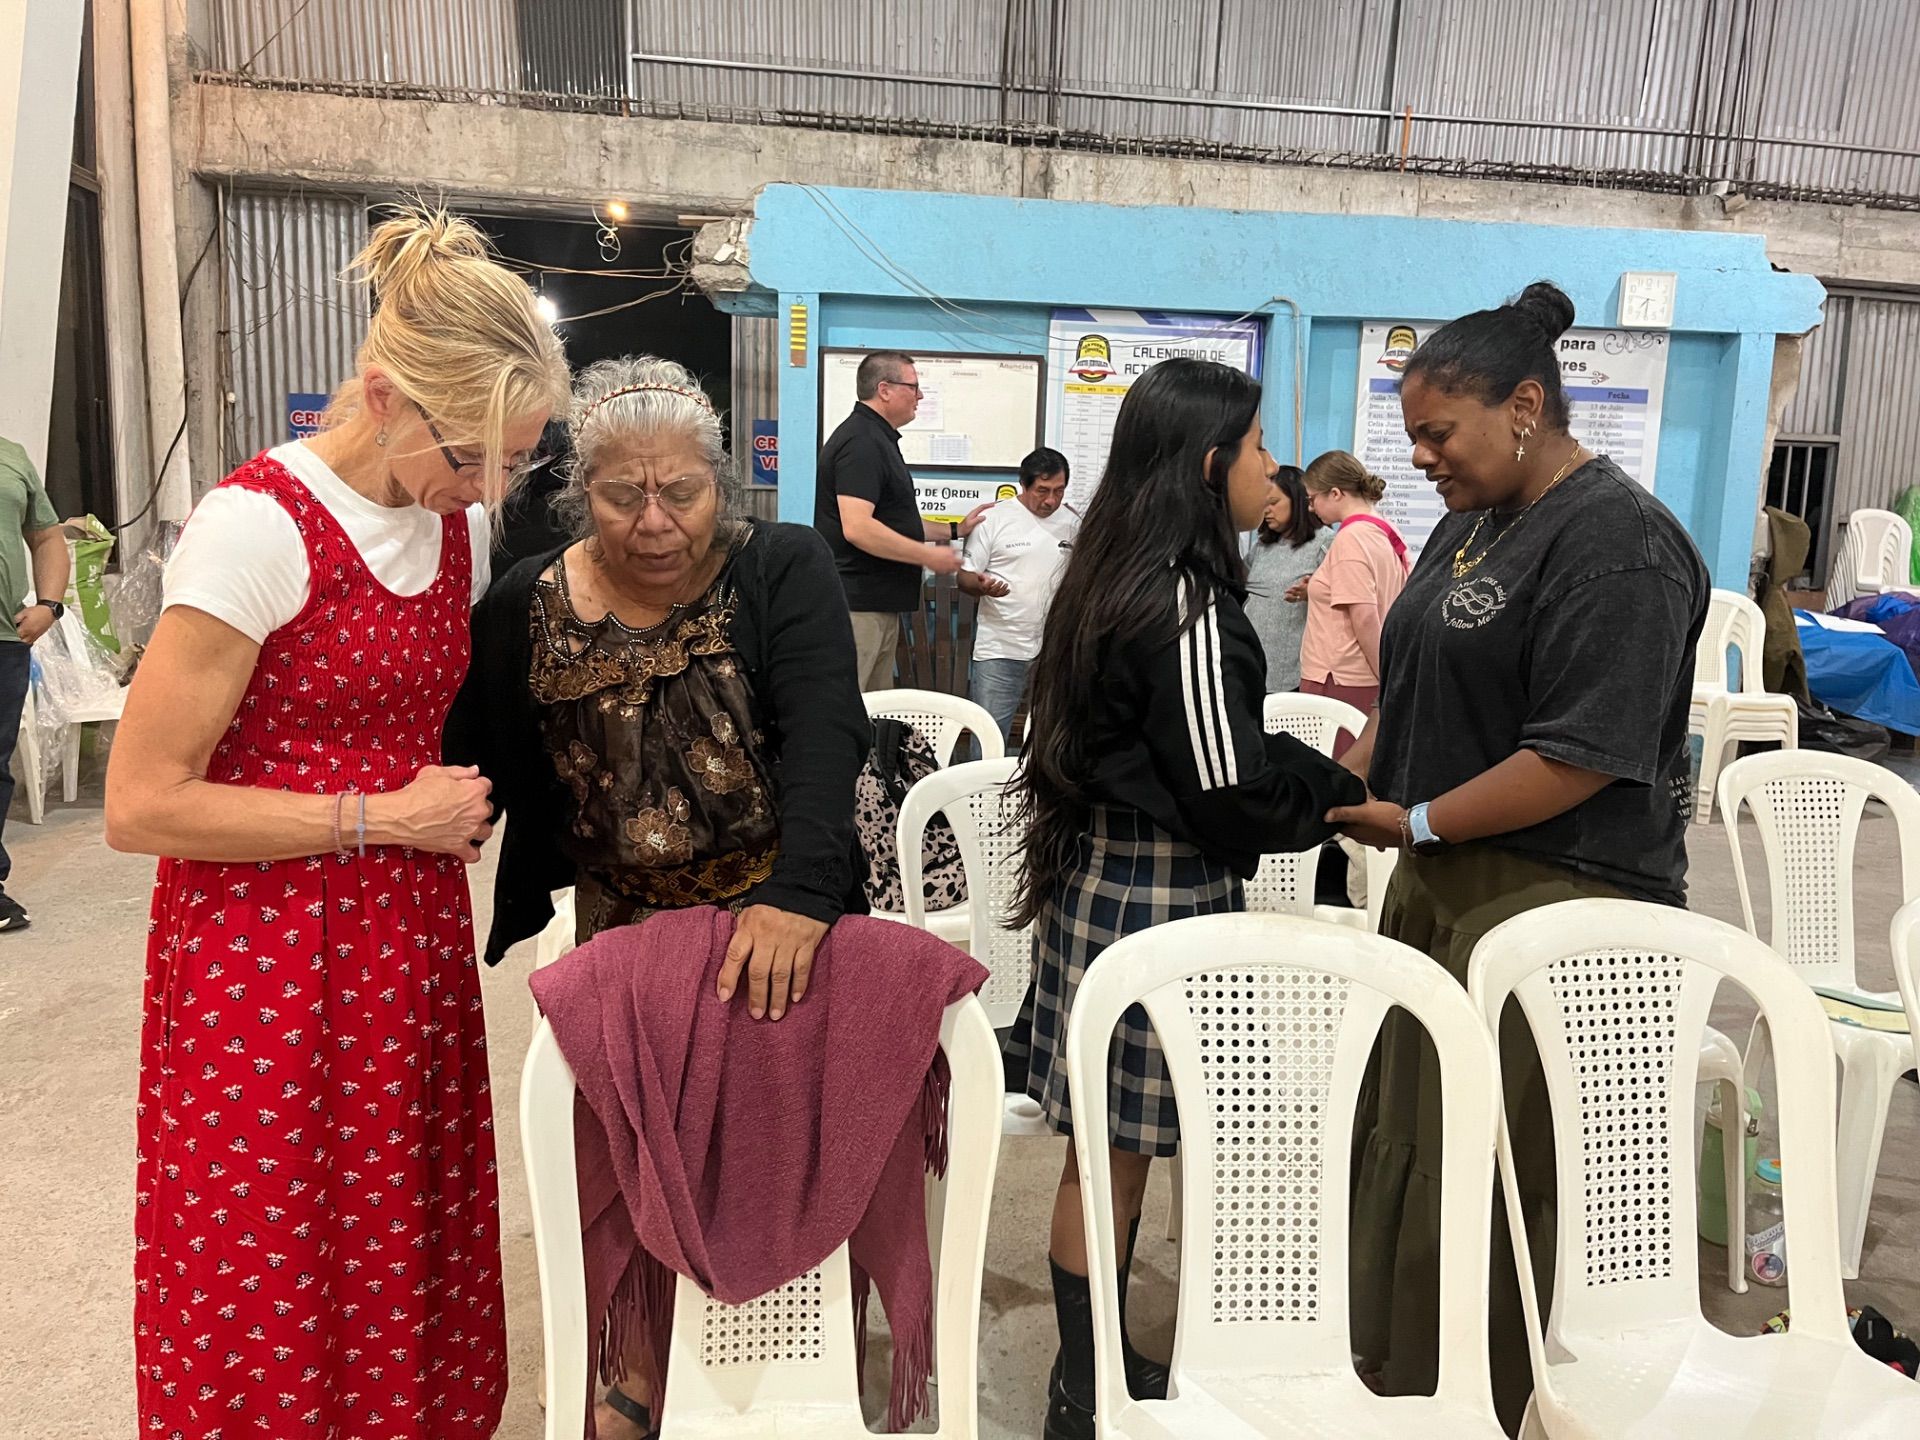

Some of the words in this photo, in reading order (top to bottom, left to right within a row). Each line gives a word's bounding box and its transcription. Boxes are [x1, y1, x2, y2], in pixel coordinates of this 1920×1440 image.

[1560, 339, 1596, 352] para
[1133, 347, 1207, 359] CALENDARIO
[1210, 350, 1226, 361] DE
[1124, 363, 1151, 375] ACT
[1560, 361, 1587, 372] res
[1607, 391, 1630, 399] Fecha
[925, 488, 938, 497] DE
[920, 502, 946, 511] 2025
